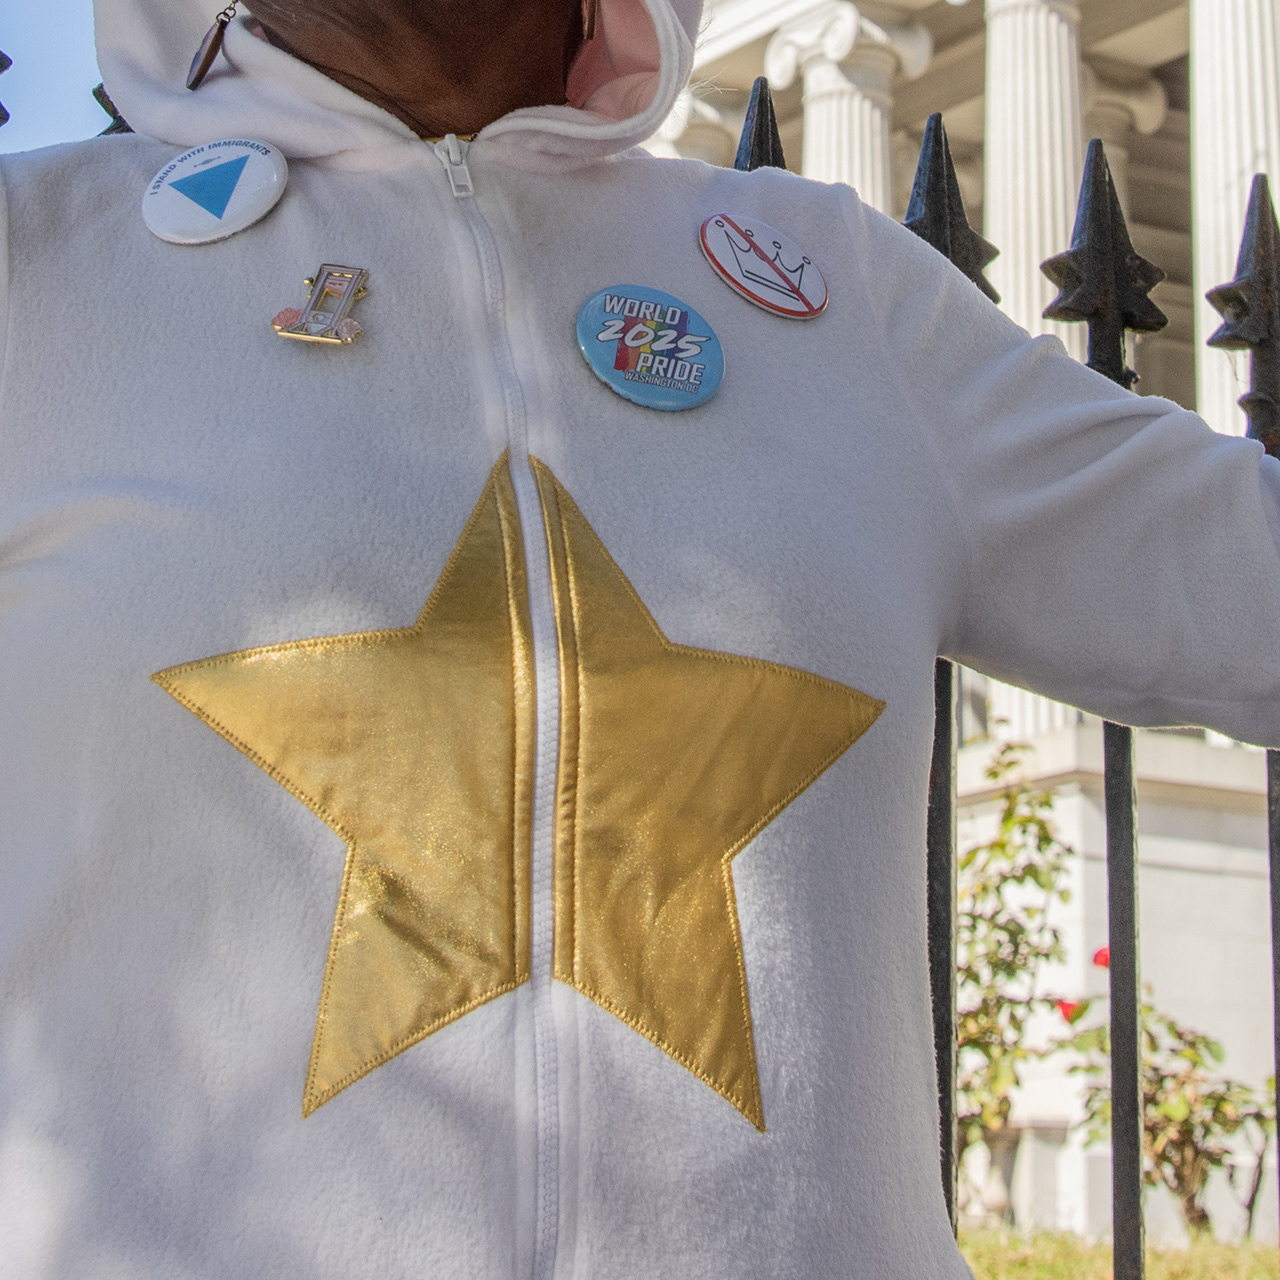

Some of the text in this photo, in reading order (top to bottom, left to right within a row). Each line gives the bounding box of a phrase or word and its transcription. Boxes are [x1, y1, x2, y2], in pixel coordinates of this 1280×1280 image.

[152, 163, 177, 190] STAND
[177, 147, 205, 163] WITH
[208, 140, 271, 156] IMMIGRANTS
[604, 294, 682, 325] WORLD
[596, 319, 711, 359] 2025
[624, 371, 699, 394] WASHINGTON DC
[635, 352, 706, 385] PRIDE
